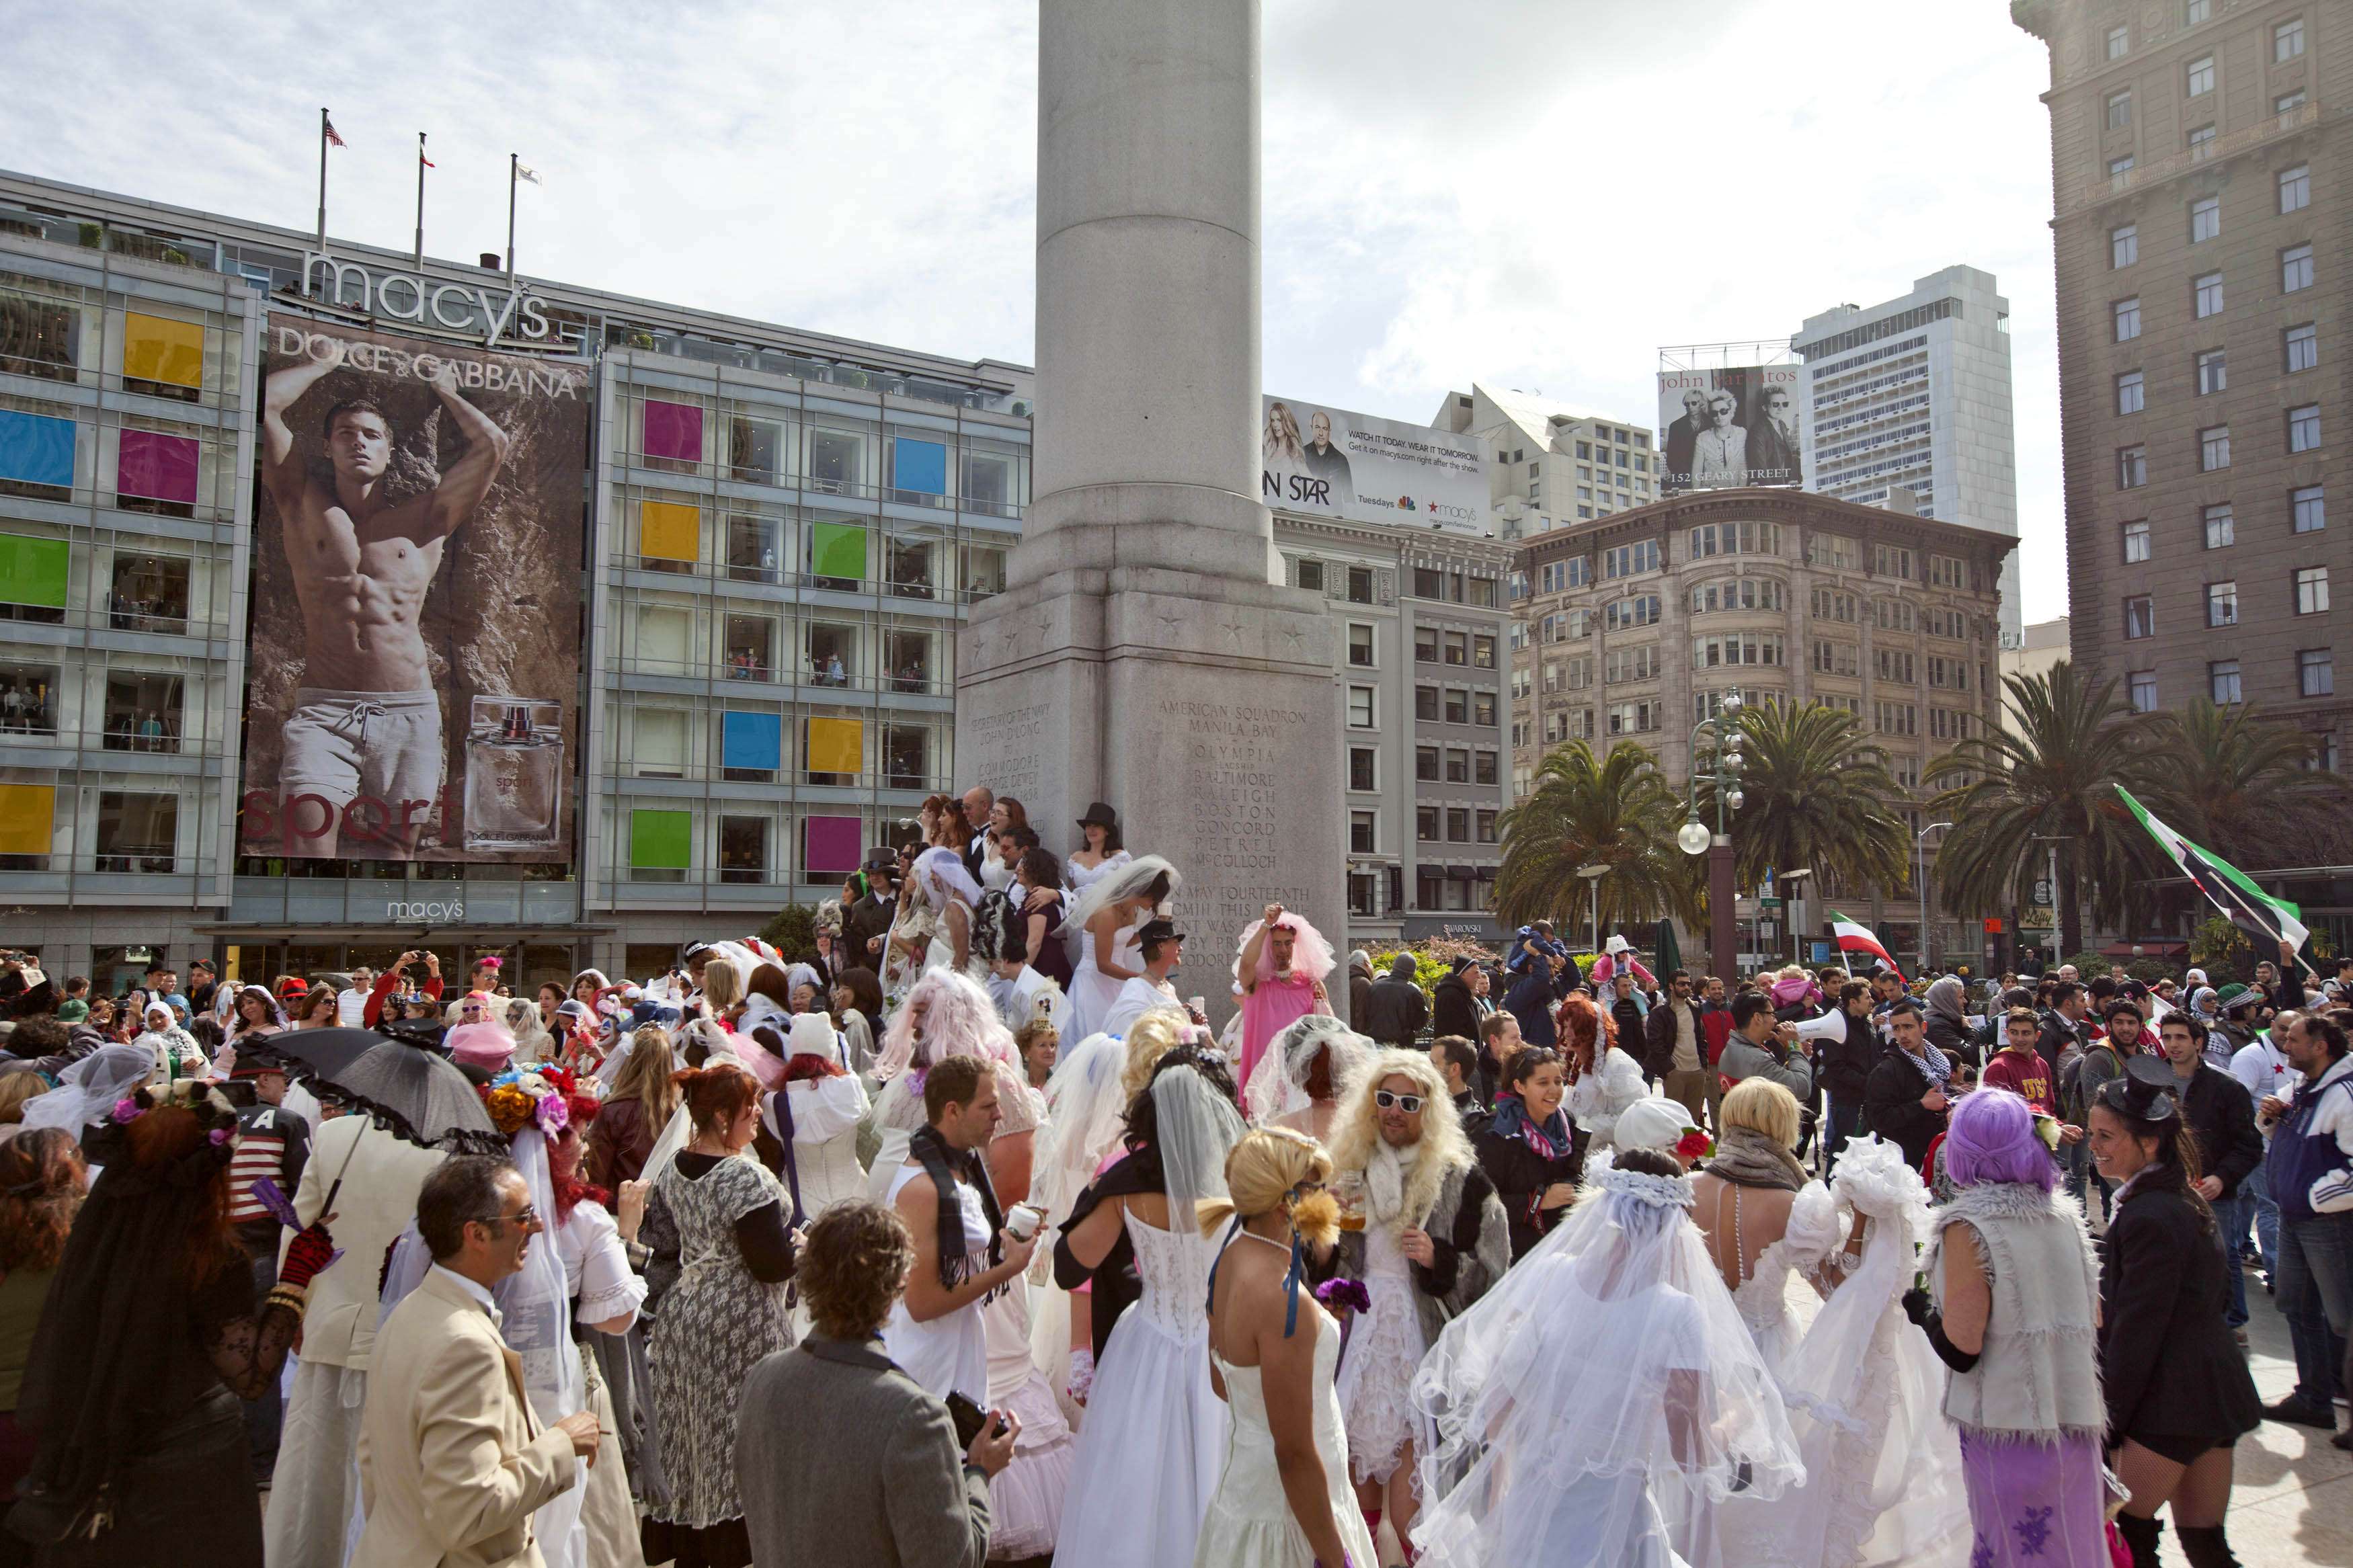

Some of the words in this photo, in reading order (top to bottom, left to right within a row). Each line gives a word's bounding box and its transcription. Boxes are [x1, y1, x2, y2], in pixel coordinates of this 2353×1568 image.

[279, 326, 391, 374] DOLCE
[395, 361, 411, 378] &
[413, 354, 577, 400] GABBANA
[1661, 371, 1704, 394] john
[1348, 429, 1373, 441] WATCH
[1375, 435, 1381, 443] IT
[1383, 437, 1406, 448] TODAY.
[1408, 441, 1429, 453] WEAR
[1430, 446, 1435, 454] IT
[1437, 447, 1479, 462] TOMORROW.
[1349, 442, 1361, 452] Get
[1363, 444, 1367, 452] it
[1380, 449, 1415, 461] macys.com
[1417, 455, 1431, 465] right
[1433, 458, 1448, 467] after
[1449, 461, 1460, 469] the
[1462, 463, 1479, 473] show.
[1671, 473, 1691, 483] 152
[1695, 470, 1738, 481] GEARY
[1741, 468, 1791, 479] STREET
[1289, 475, 1330, 505] STAR
[1357, 495, 1394, 509] Tuesdays
[1160, 700, 1228, 717] AMERICAN
[1236, 707, 1307, 724] SQUADRON
[1189, 719, 1244, 736] MANILA
[1253, 725, 1277, 738] BAY
[1195, 745, 1274, 763] OLYMPIA
[978, 754, 1039, 776] COMMODORE
[496, 776, 532, 791] sport
[1011, 771, 1039, 787] DEWEY
[1194, 770, 1275, 787] BALTIMORE
[1194, 786, 1275, 802] RALEIGH
[1194, 803, 1275, 819] BOSTON
[243, 785, 459, 857] sport
[1195, 820, 1275, 835] CONCORD
[472, 833, 501, 841] DOLCE
[1195, 837, 1275, 852] PETREL
[1188, 886, 1215, 899] MAY
[1221, 886, 1309, 901] FOURTEENTH
[1219, 903, 1251, 917] THIS
[1206, 919, 1236, 933] WAS
[1443, 924, 1482, 933] SWAROVSKI
[1190, 936, 1207, 950] BY
[251, 1110, 276, 1128] A
